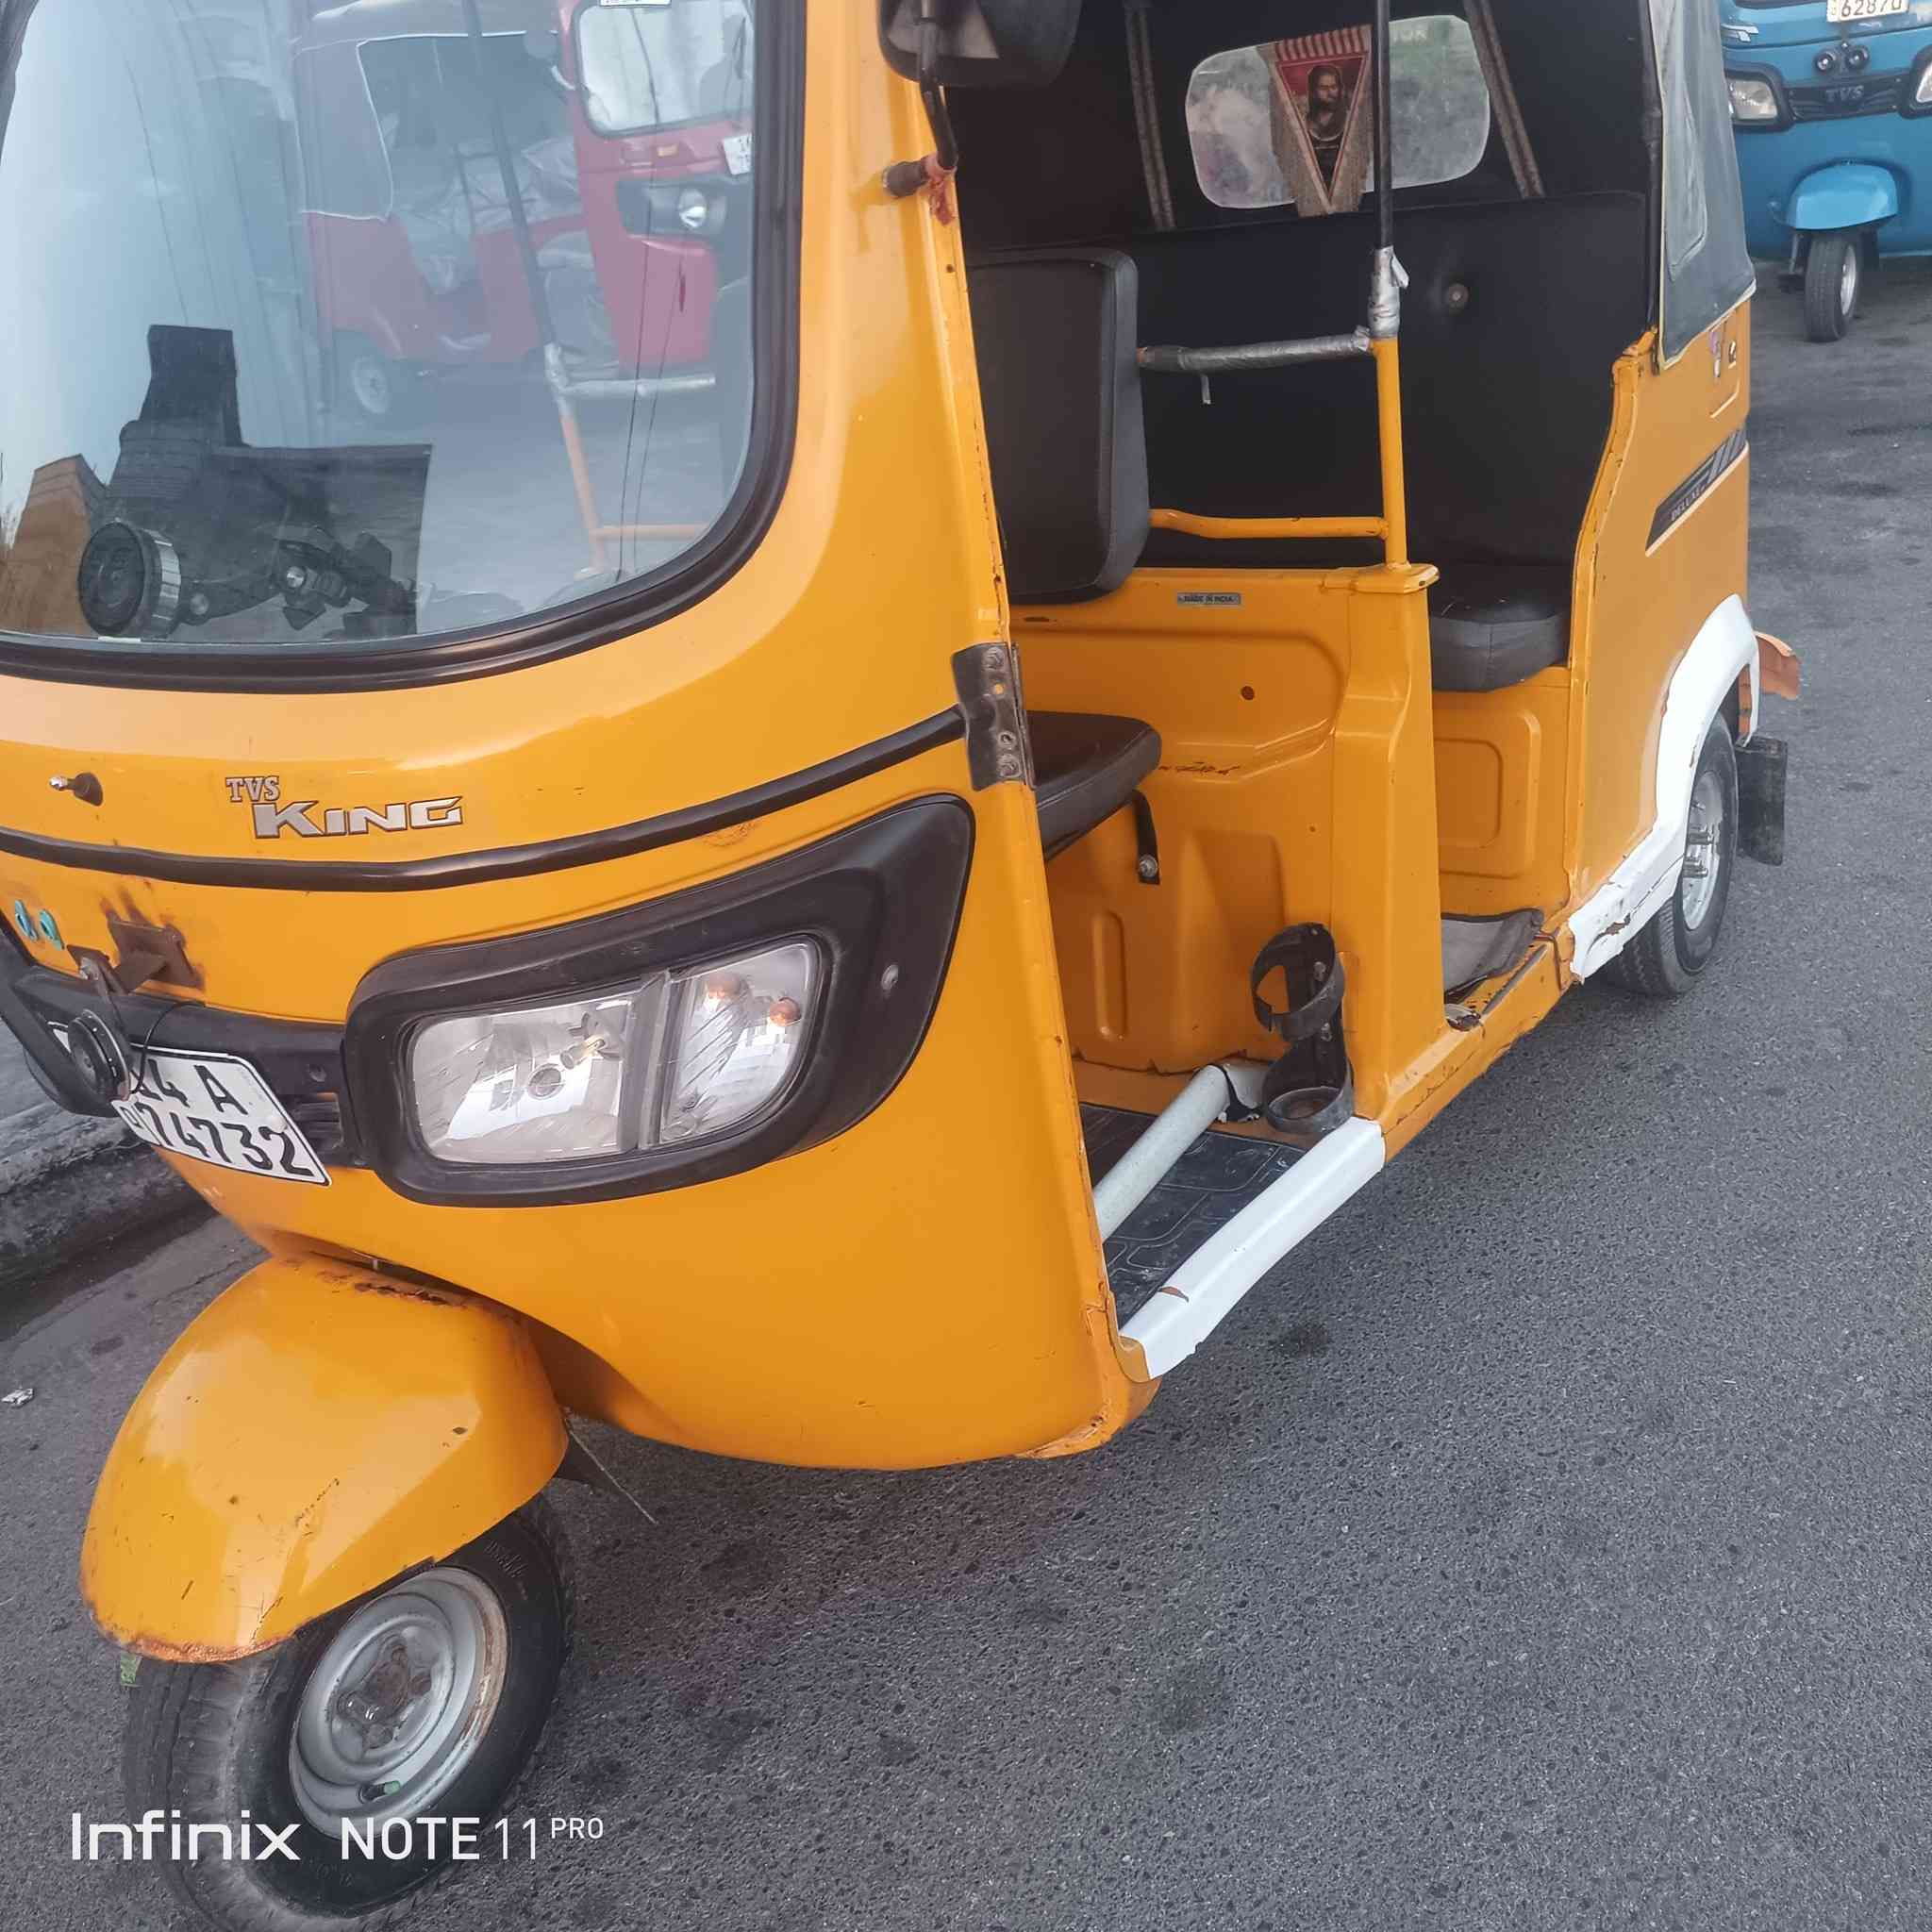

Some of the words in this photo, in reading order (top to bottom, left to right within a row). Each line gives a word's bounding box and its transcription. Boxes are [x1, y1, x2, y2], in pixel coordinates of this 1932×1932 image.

[1826, 84, 1864, 103] TVS
[225, 775, 280, 802] TVS
[252, 795, 463, 839] KING
[193, 1064, 249, 1116] A
[134, 1101, 315, 1177] 74732
